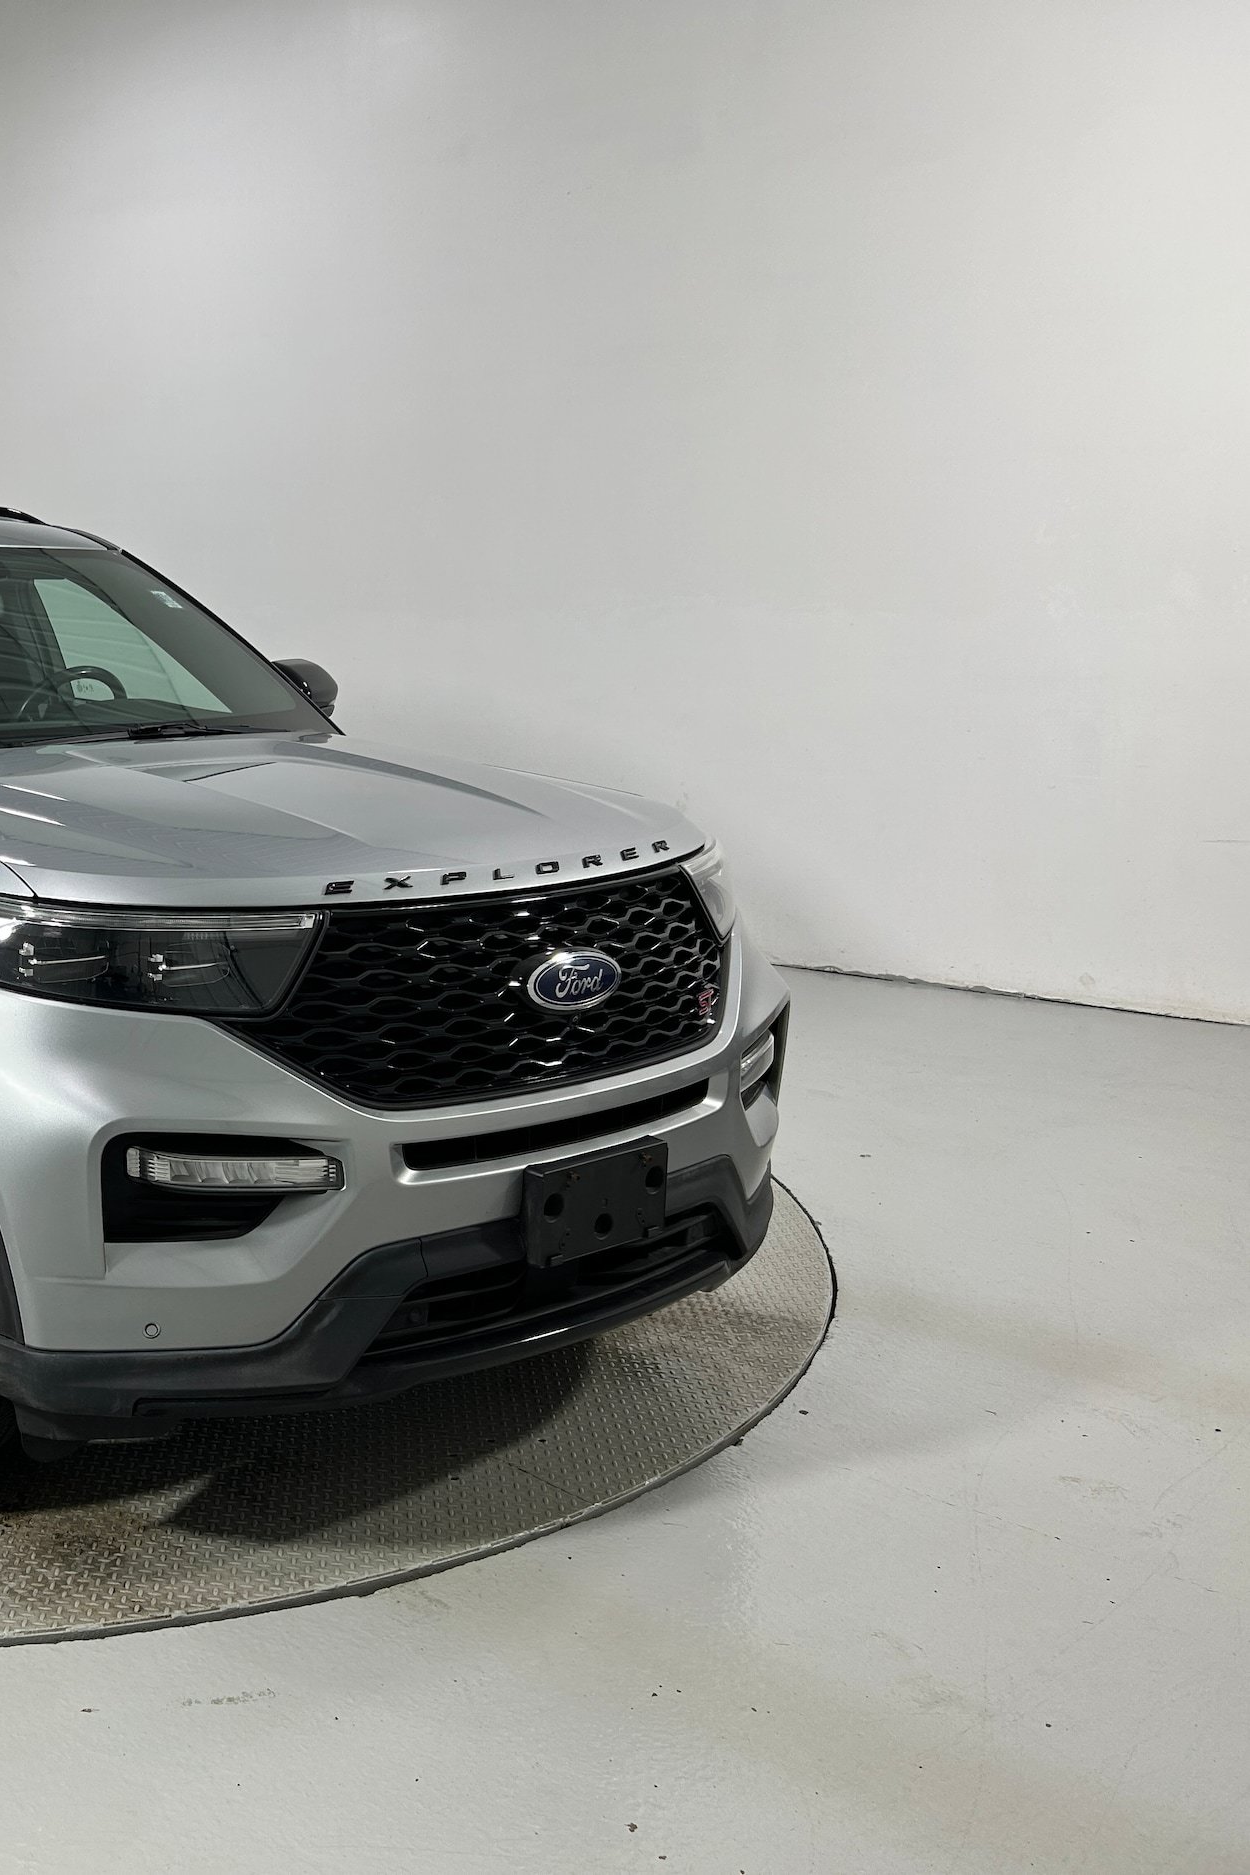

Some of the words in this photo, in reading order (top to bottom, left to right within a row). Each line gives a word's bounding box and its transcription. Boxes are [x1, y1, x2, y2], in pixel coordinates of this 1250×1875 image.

[322, 840, 670, 895] EXPLORER
[554, 963, 603, 999] Ford
[698, 988, 714, 1016] ST
